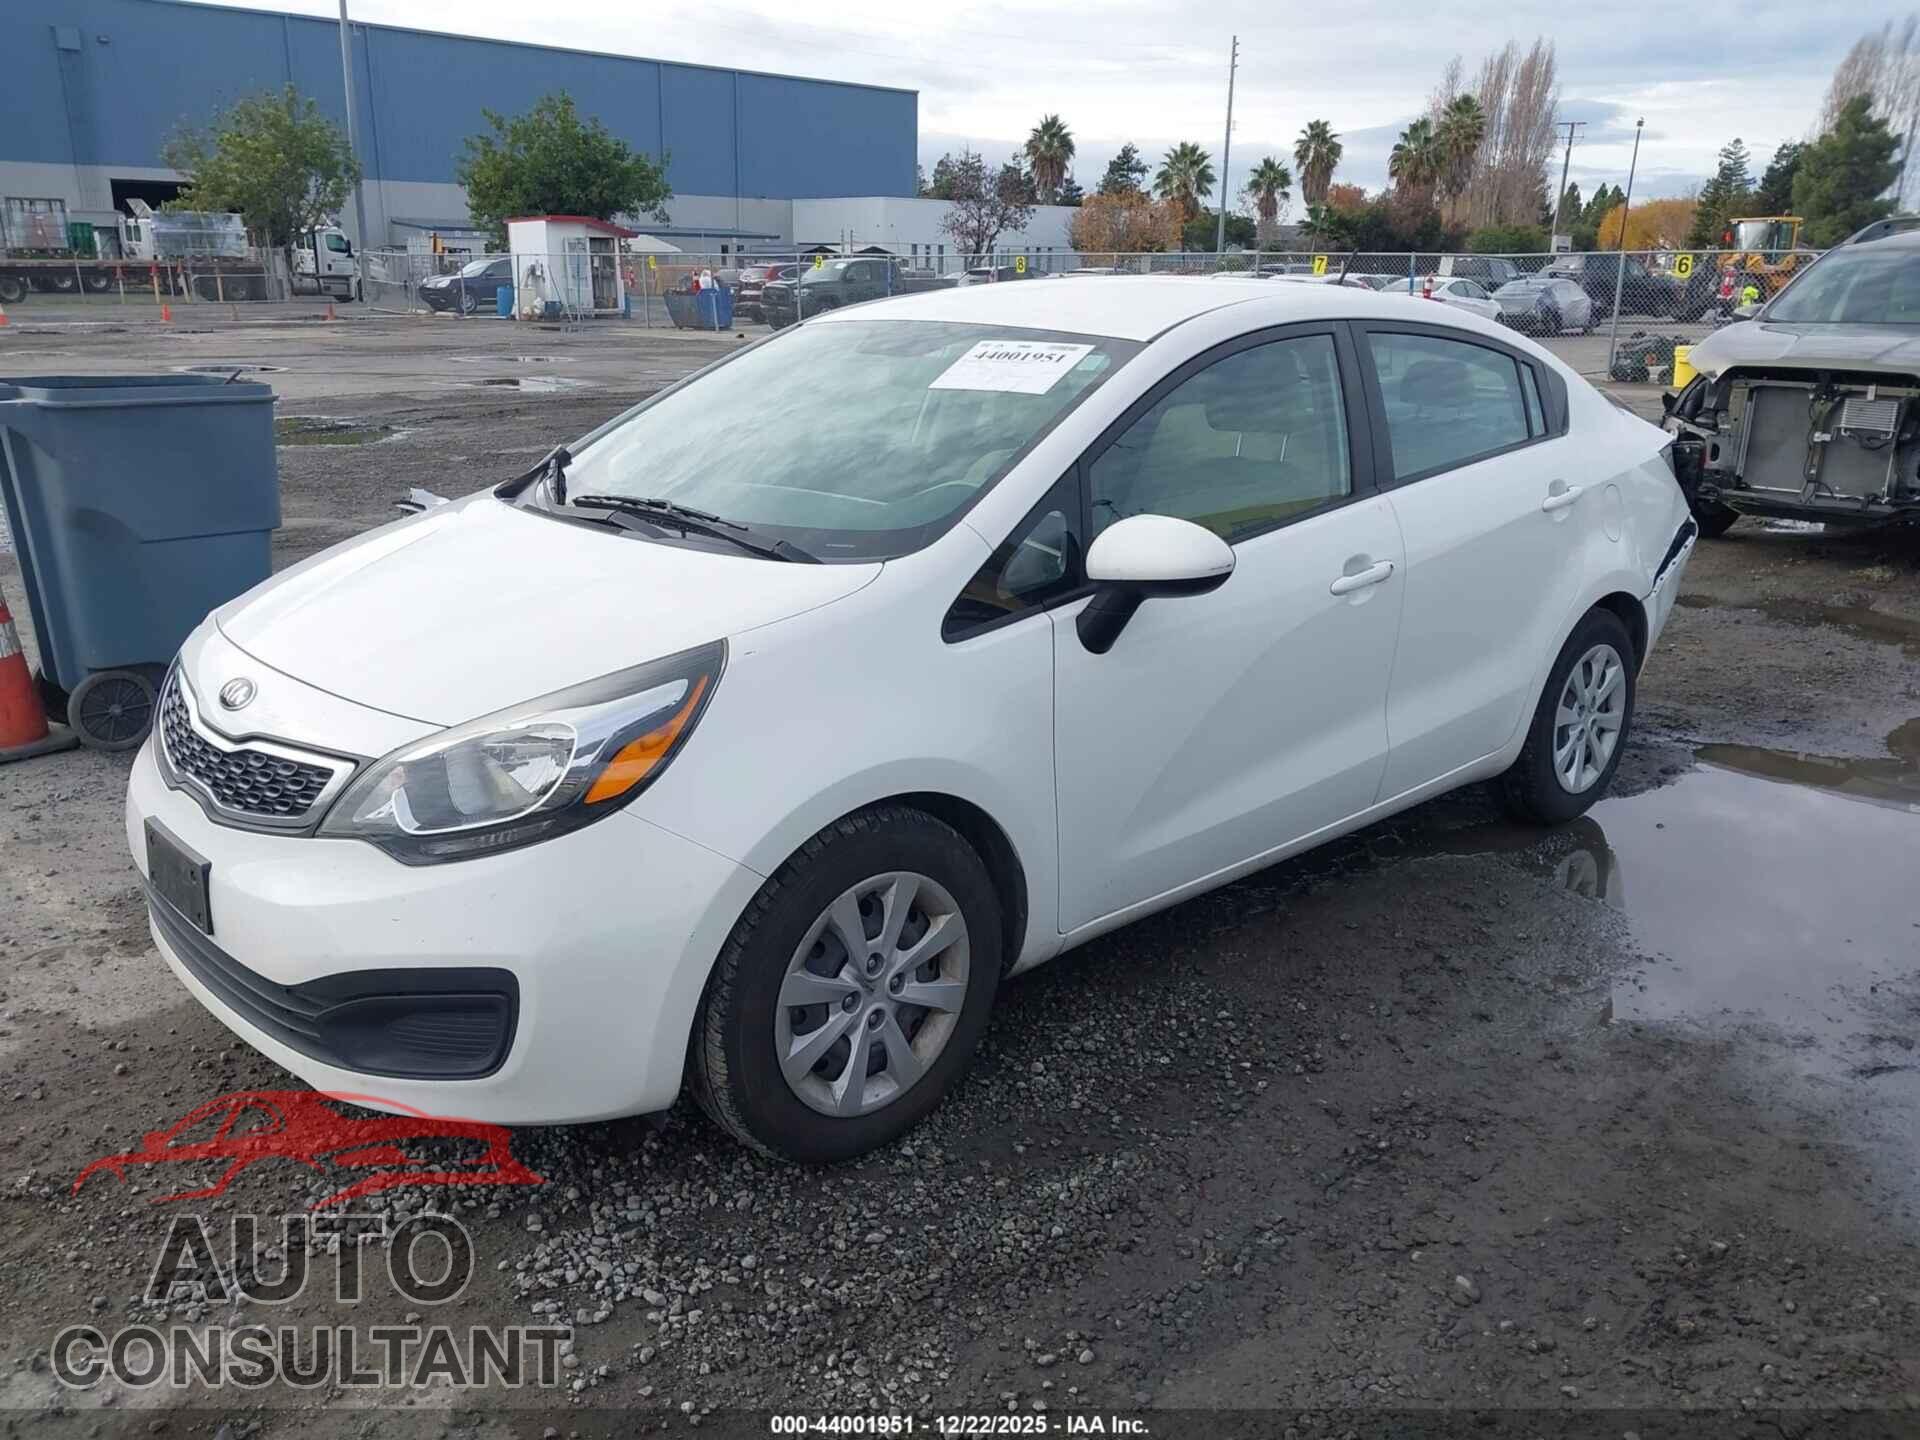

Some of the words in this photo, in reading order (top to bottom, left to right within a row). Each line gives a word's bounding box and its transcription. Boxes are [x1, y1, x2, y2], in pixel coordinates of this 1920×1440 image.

[1017, 257, 1024, 271] 8
[1316, 257, 1325, 272] 7
[1678, 256, 1690, 273] 6
[974, 351, 1067, 363] 44001951
